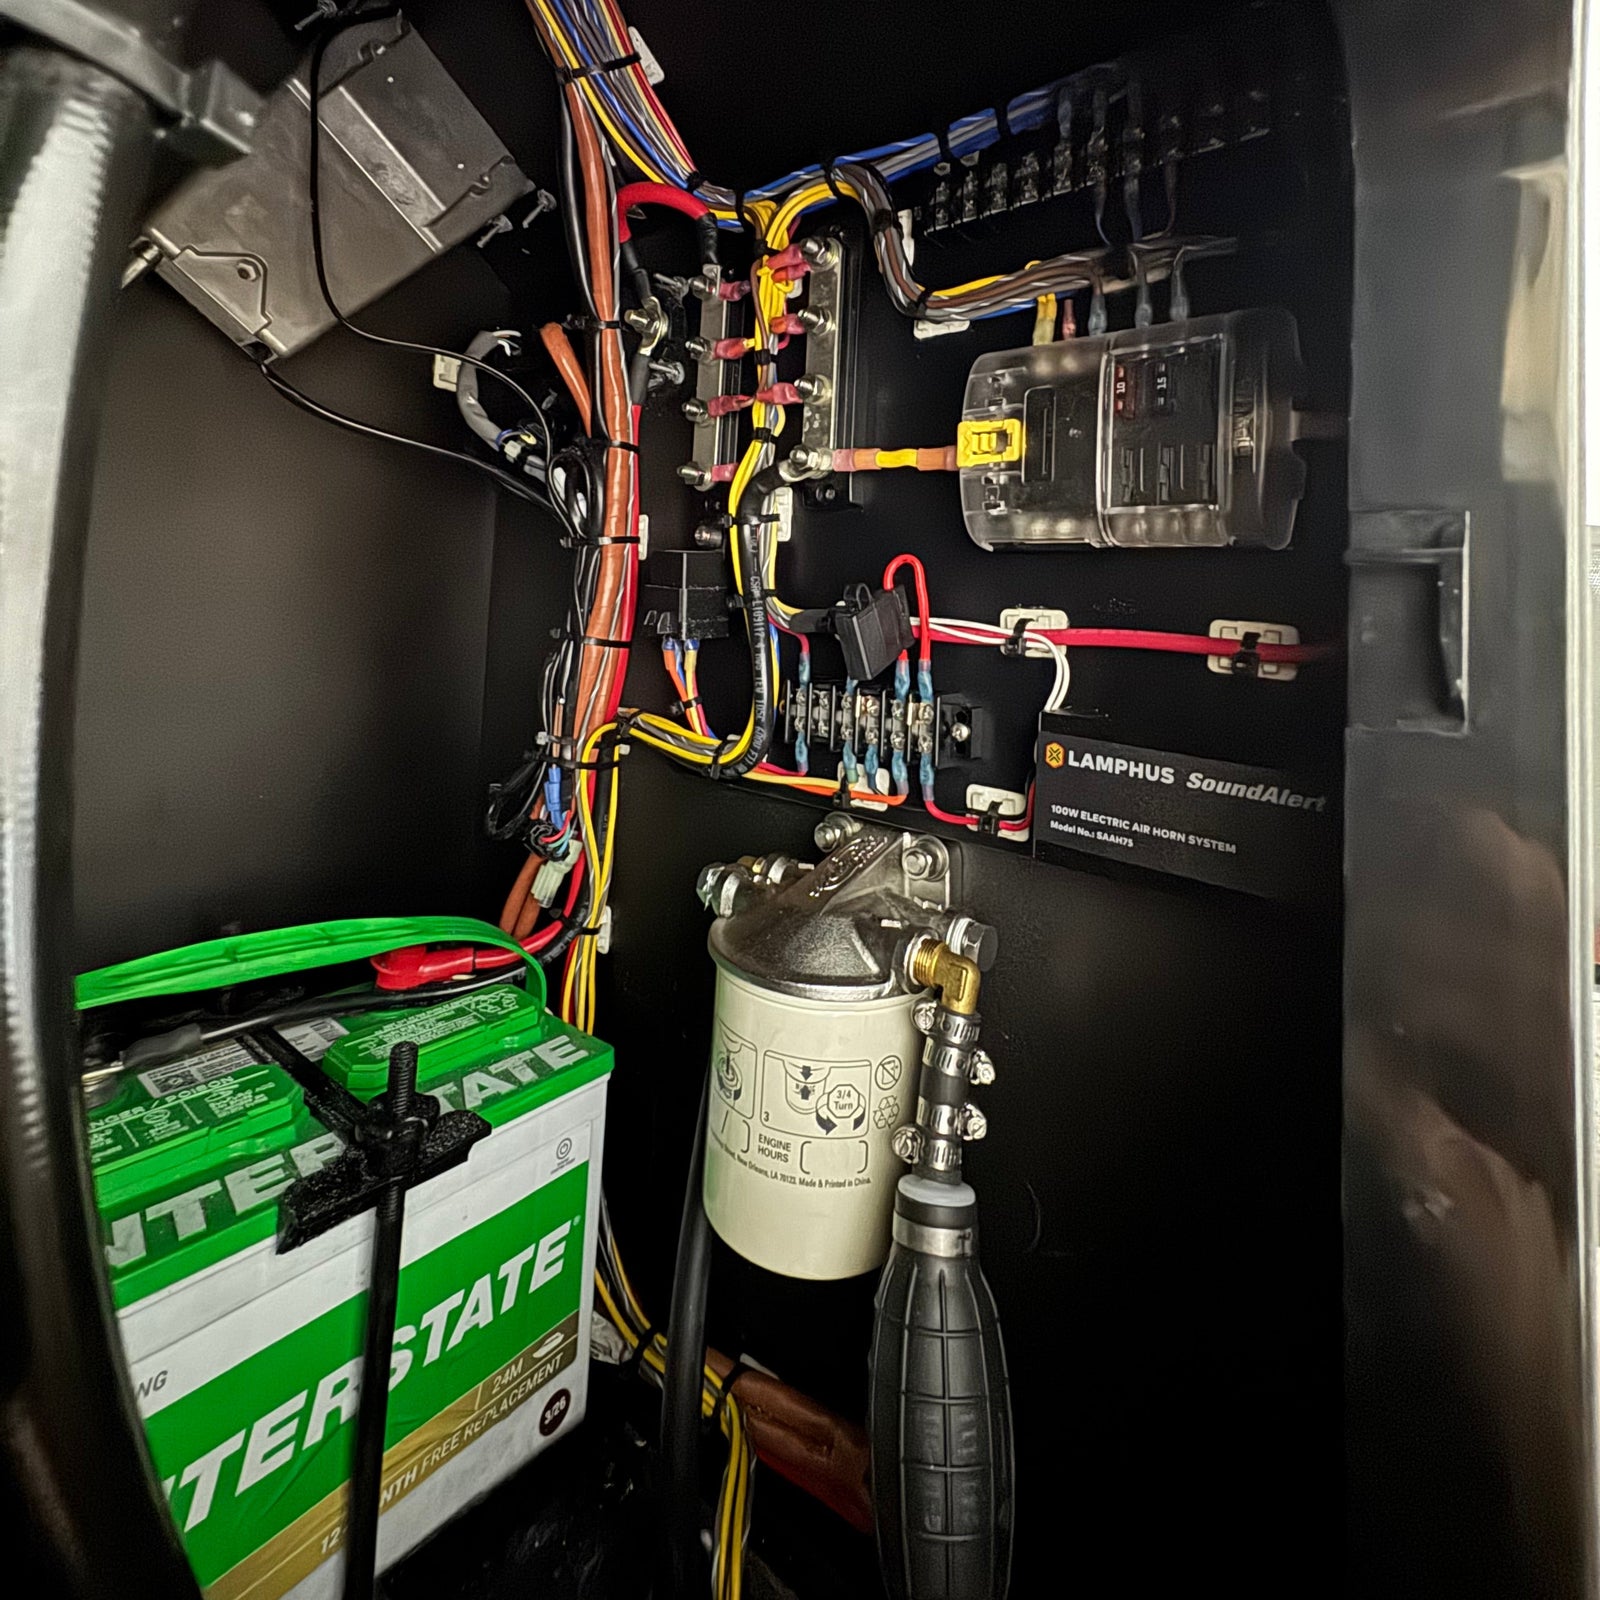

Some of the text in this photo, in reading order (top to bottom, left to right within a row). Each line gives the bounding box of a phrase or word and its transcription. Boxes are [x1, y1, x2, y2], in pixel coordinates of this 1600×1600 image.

[1116, 381, 1126, 394] 10
[1156, 376, 1167, 390] 15
[1067, 750, 1328, 812] LAMPHUS SoundAlert
[1050, 804, 1237, 854] 100W ELECTRIC AIR HORN SYSTEM
[1050, 820, 1076, 834] Model
[1096, 831, 1134, 848] SAAH75
[89, 1105, 146, 1129] NGER
[165, 1075, 236, 1103] POISON
[836, 1089, 852, 1100] 3/4
[833, 1101, 854, 1111] Turn
[763, 1111, 770, 1122] 3
[758, 1133, 792, 1152] ENGINE
[757, 1144, 790, 1163] HOURS
[798, 1177, 816, 1188] Made
[491, 1357, 524, 1394] 24M
[420, 1431, 462, 1475] FREE
[463, 1352, 564, 1442] REPLACEMENT
